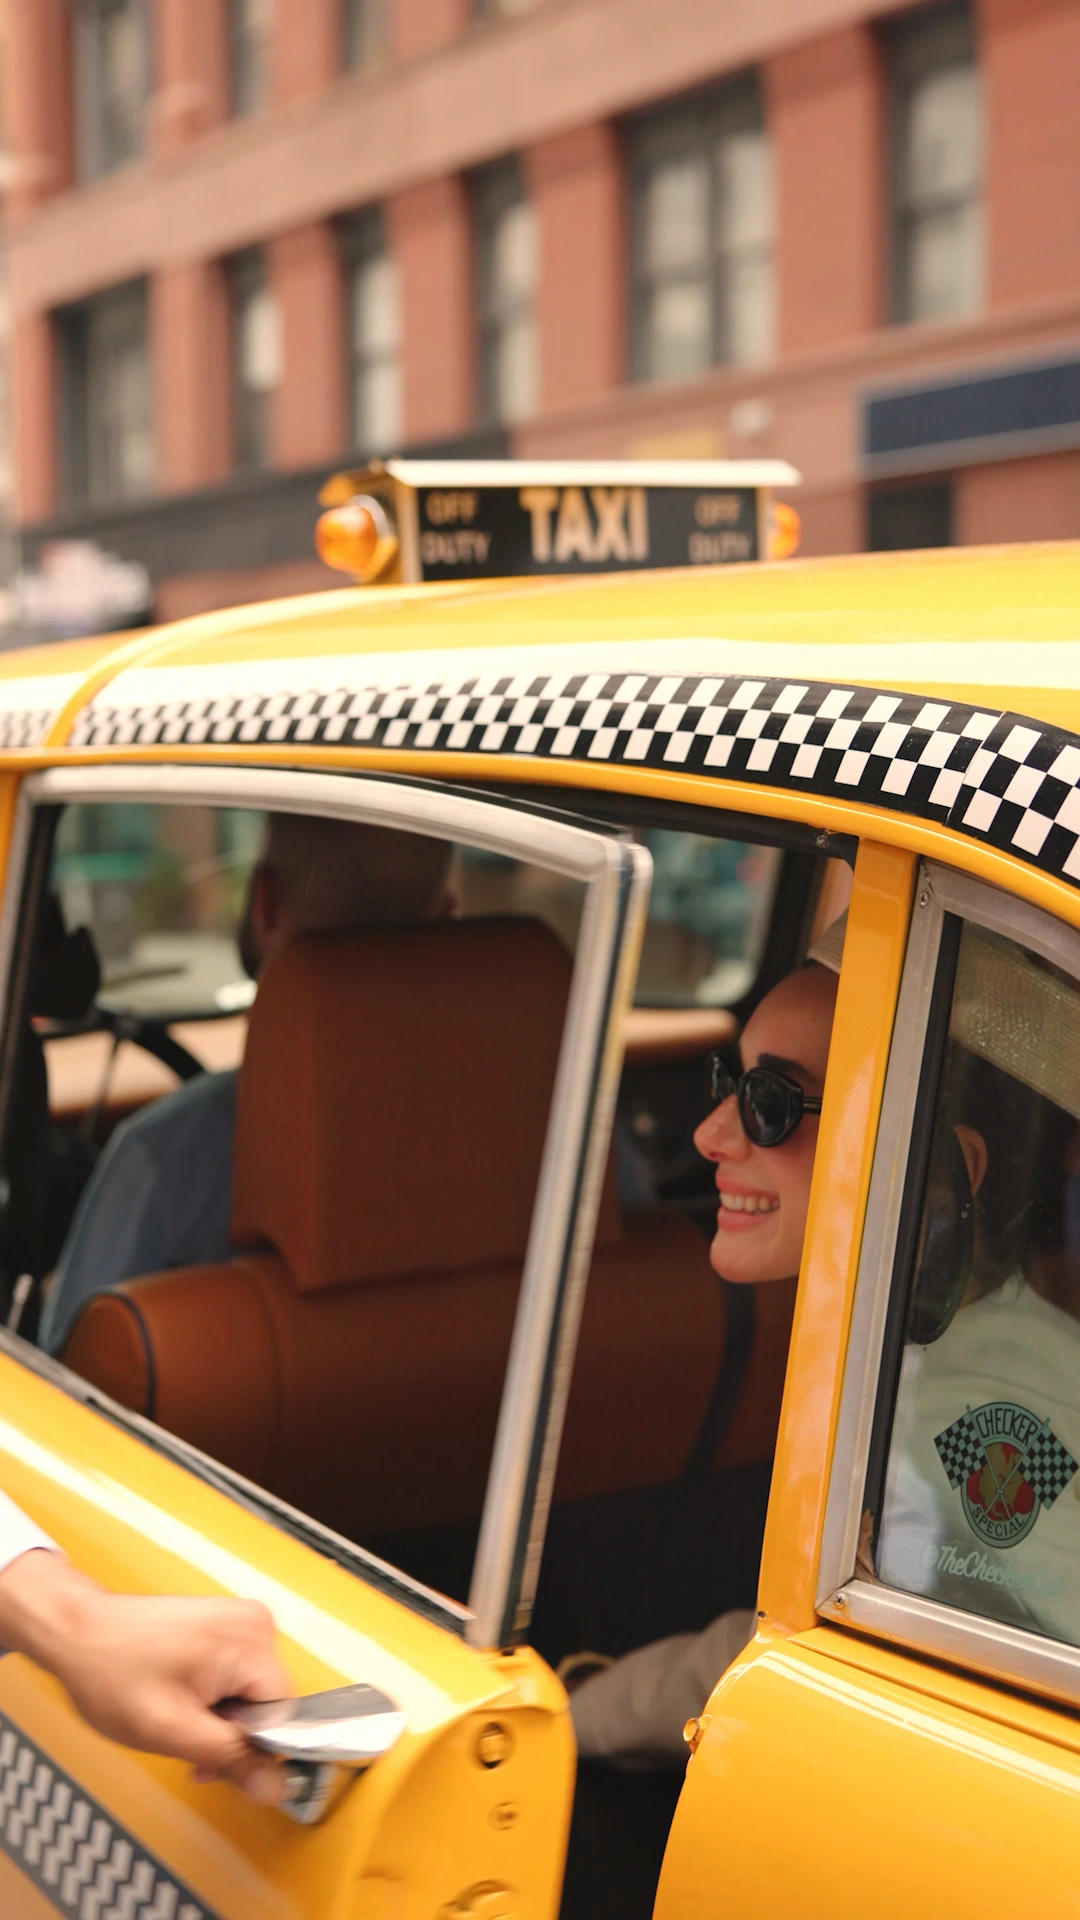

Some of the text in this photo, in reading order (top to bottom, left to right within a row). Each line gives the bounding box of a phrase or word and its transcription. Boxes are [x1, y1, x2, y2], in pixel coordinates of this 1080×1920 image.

[426, 492, 477, 525] OFF
[519, 488, 650, 562] TAXI
[694, 494, 741, 528] OFF
[422, 531, 491, 565] DUTY
[974, 1408, 1038, 1447] CHECKER
[971, 1506, 1025, 1537] SPECIAL
[923, 1546, 1067, 1597] @TheCheckeCab
